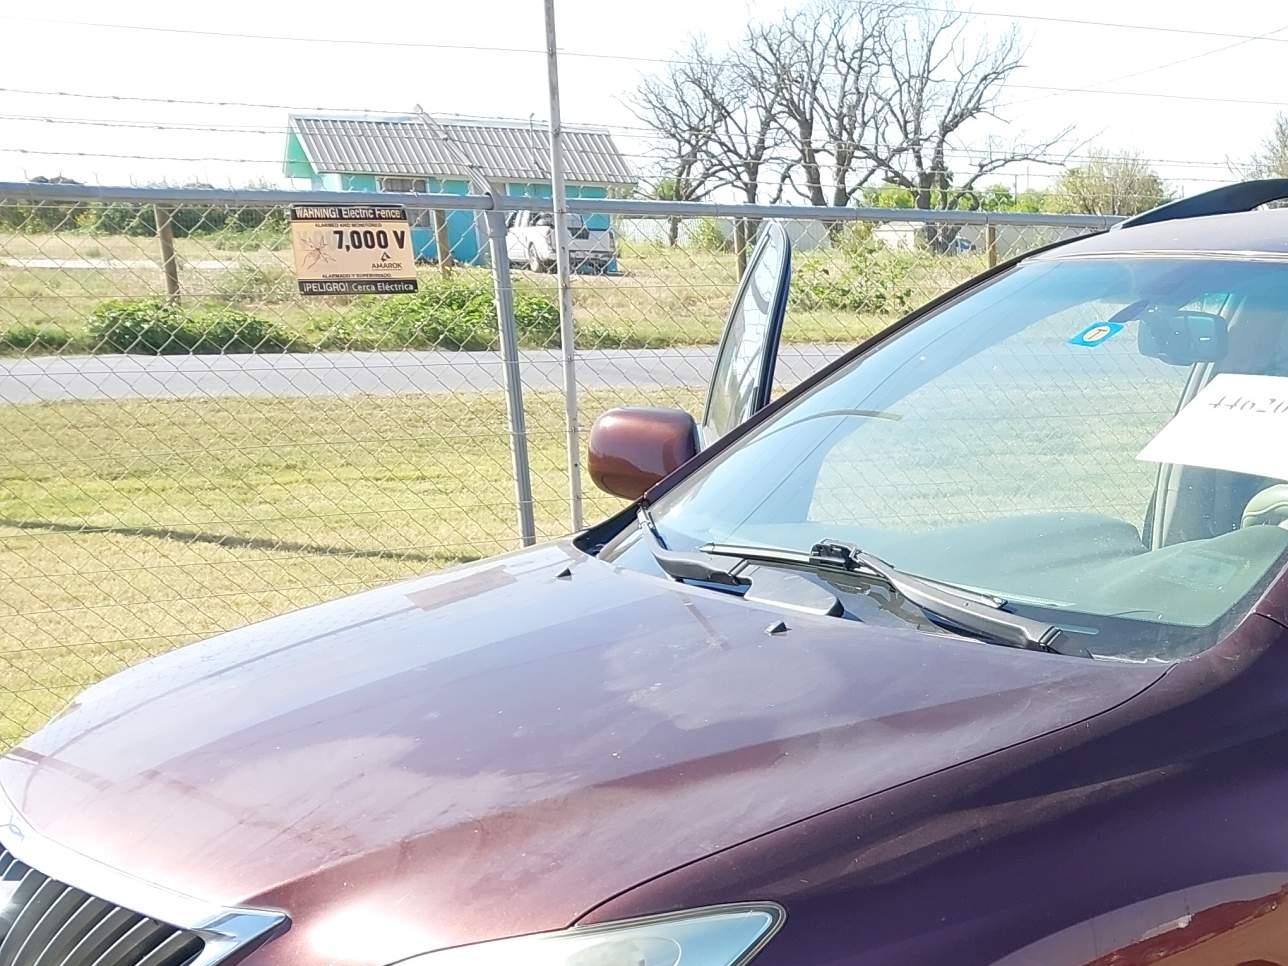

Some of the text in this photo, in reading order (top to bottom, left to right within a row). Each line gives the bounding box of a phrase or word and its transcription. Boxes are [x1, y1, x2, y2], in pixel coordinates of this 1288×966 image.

[296, 208, 339, 218] WARNING!
[342, 208, 374, 218] Electric
[333, 230, 406, 252] 7,000 V
[303, 282, 414, 292] ¡PELIGRO! Cerca Eléctrica
